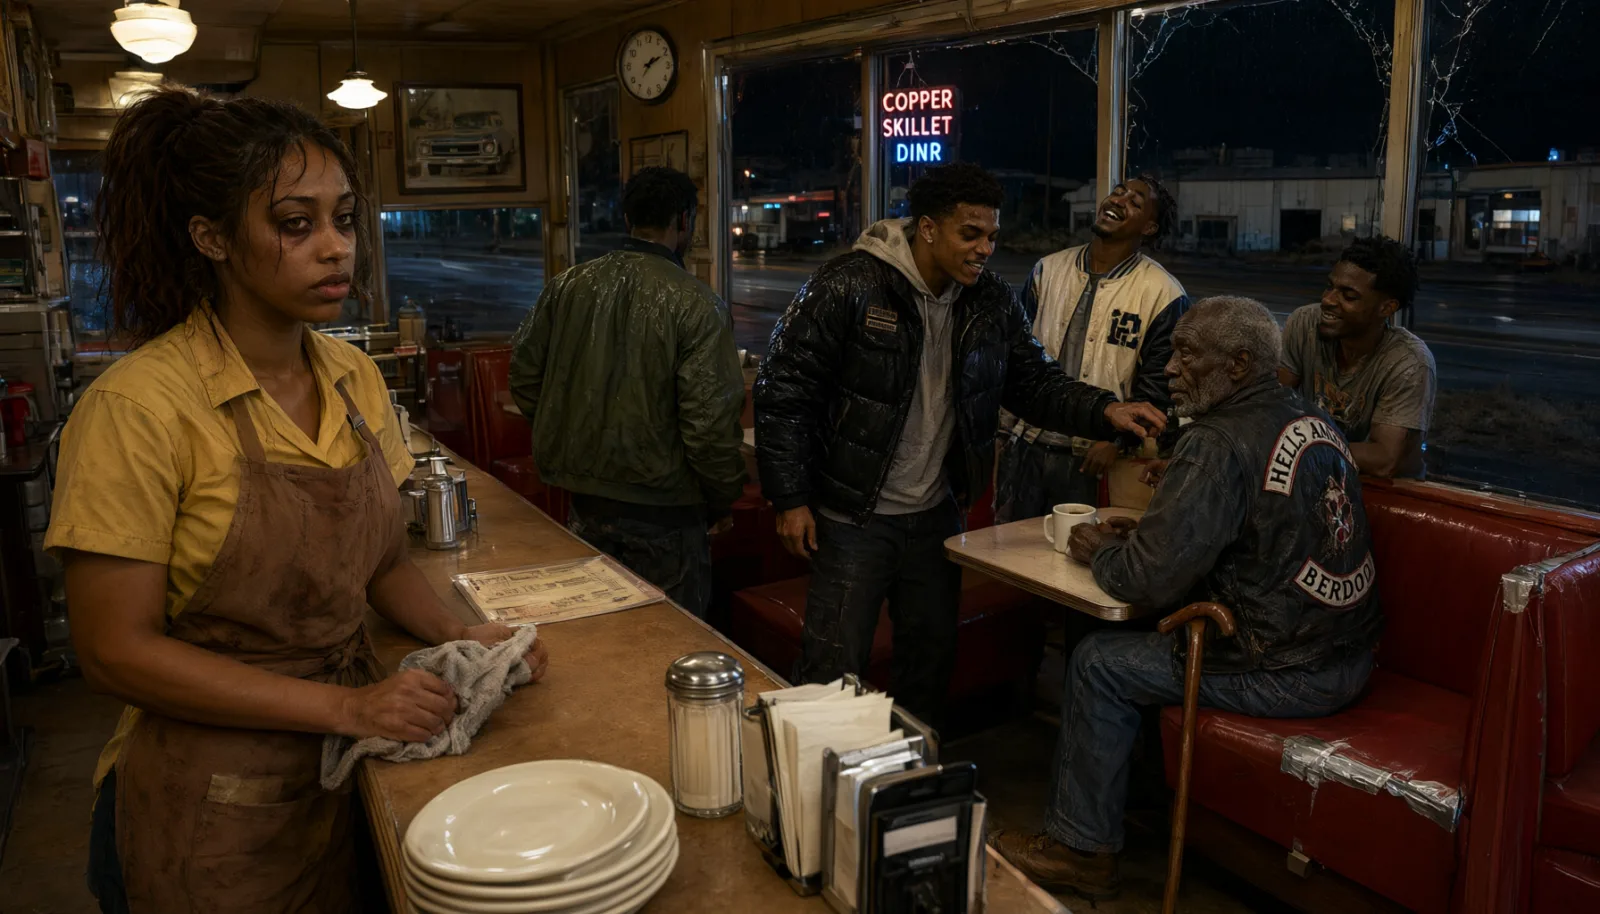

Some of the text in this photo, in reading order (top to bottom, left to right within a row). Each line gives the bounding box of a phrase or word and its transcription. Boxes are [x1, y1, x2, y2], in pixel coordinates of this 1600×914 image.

[882, 89, 953, 112] COPPER
[882, 116, 953, 138] SKILLET
[896, 142, 942, 162] DINR
[1270, 424, 1308, 486] HELLS
